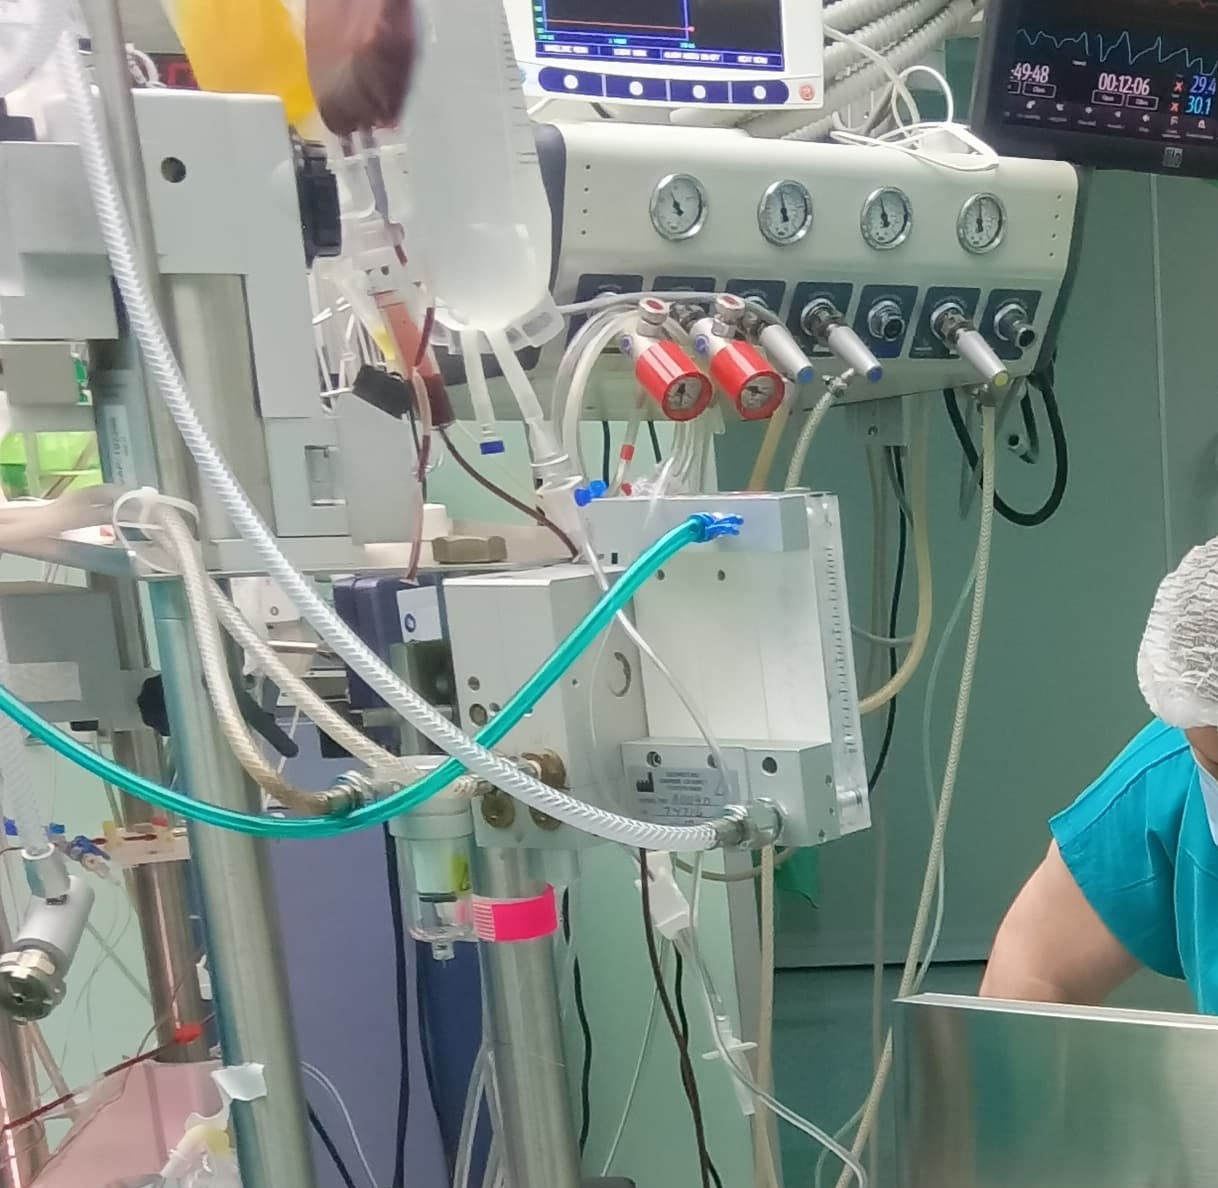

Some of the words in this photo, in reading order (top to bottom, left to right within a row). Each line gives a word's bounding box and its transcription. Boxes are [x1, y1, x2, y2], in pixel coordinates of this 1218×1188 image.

[1098, 72, 1151, 96] 00:12:06
[1190, 74, 1217, 95] 29.4
[1185, 95, 1212, 115] 30.1
